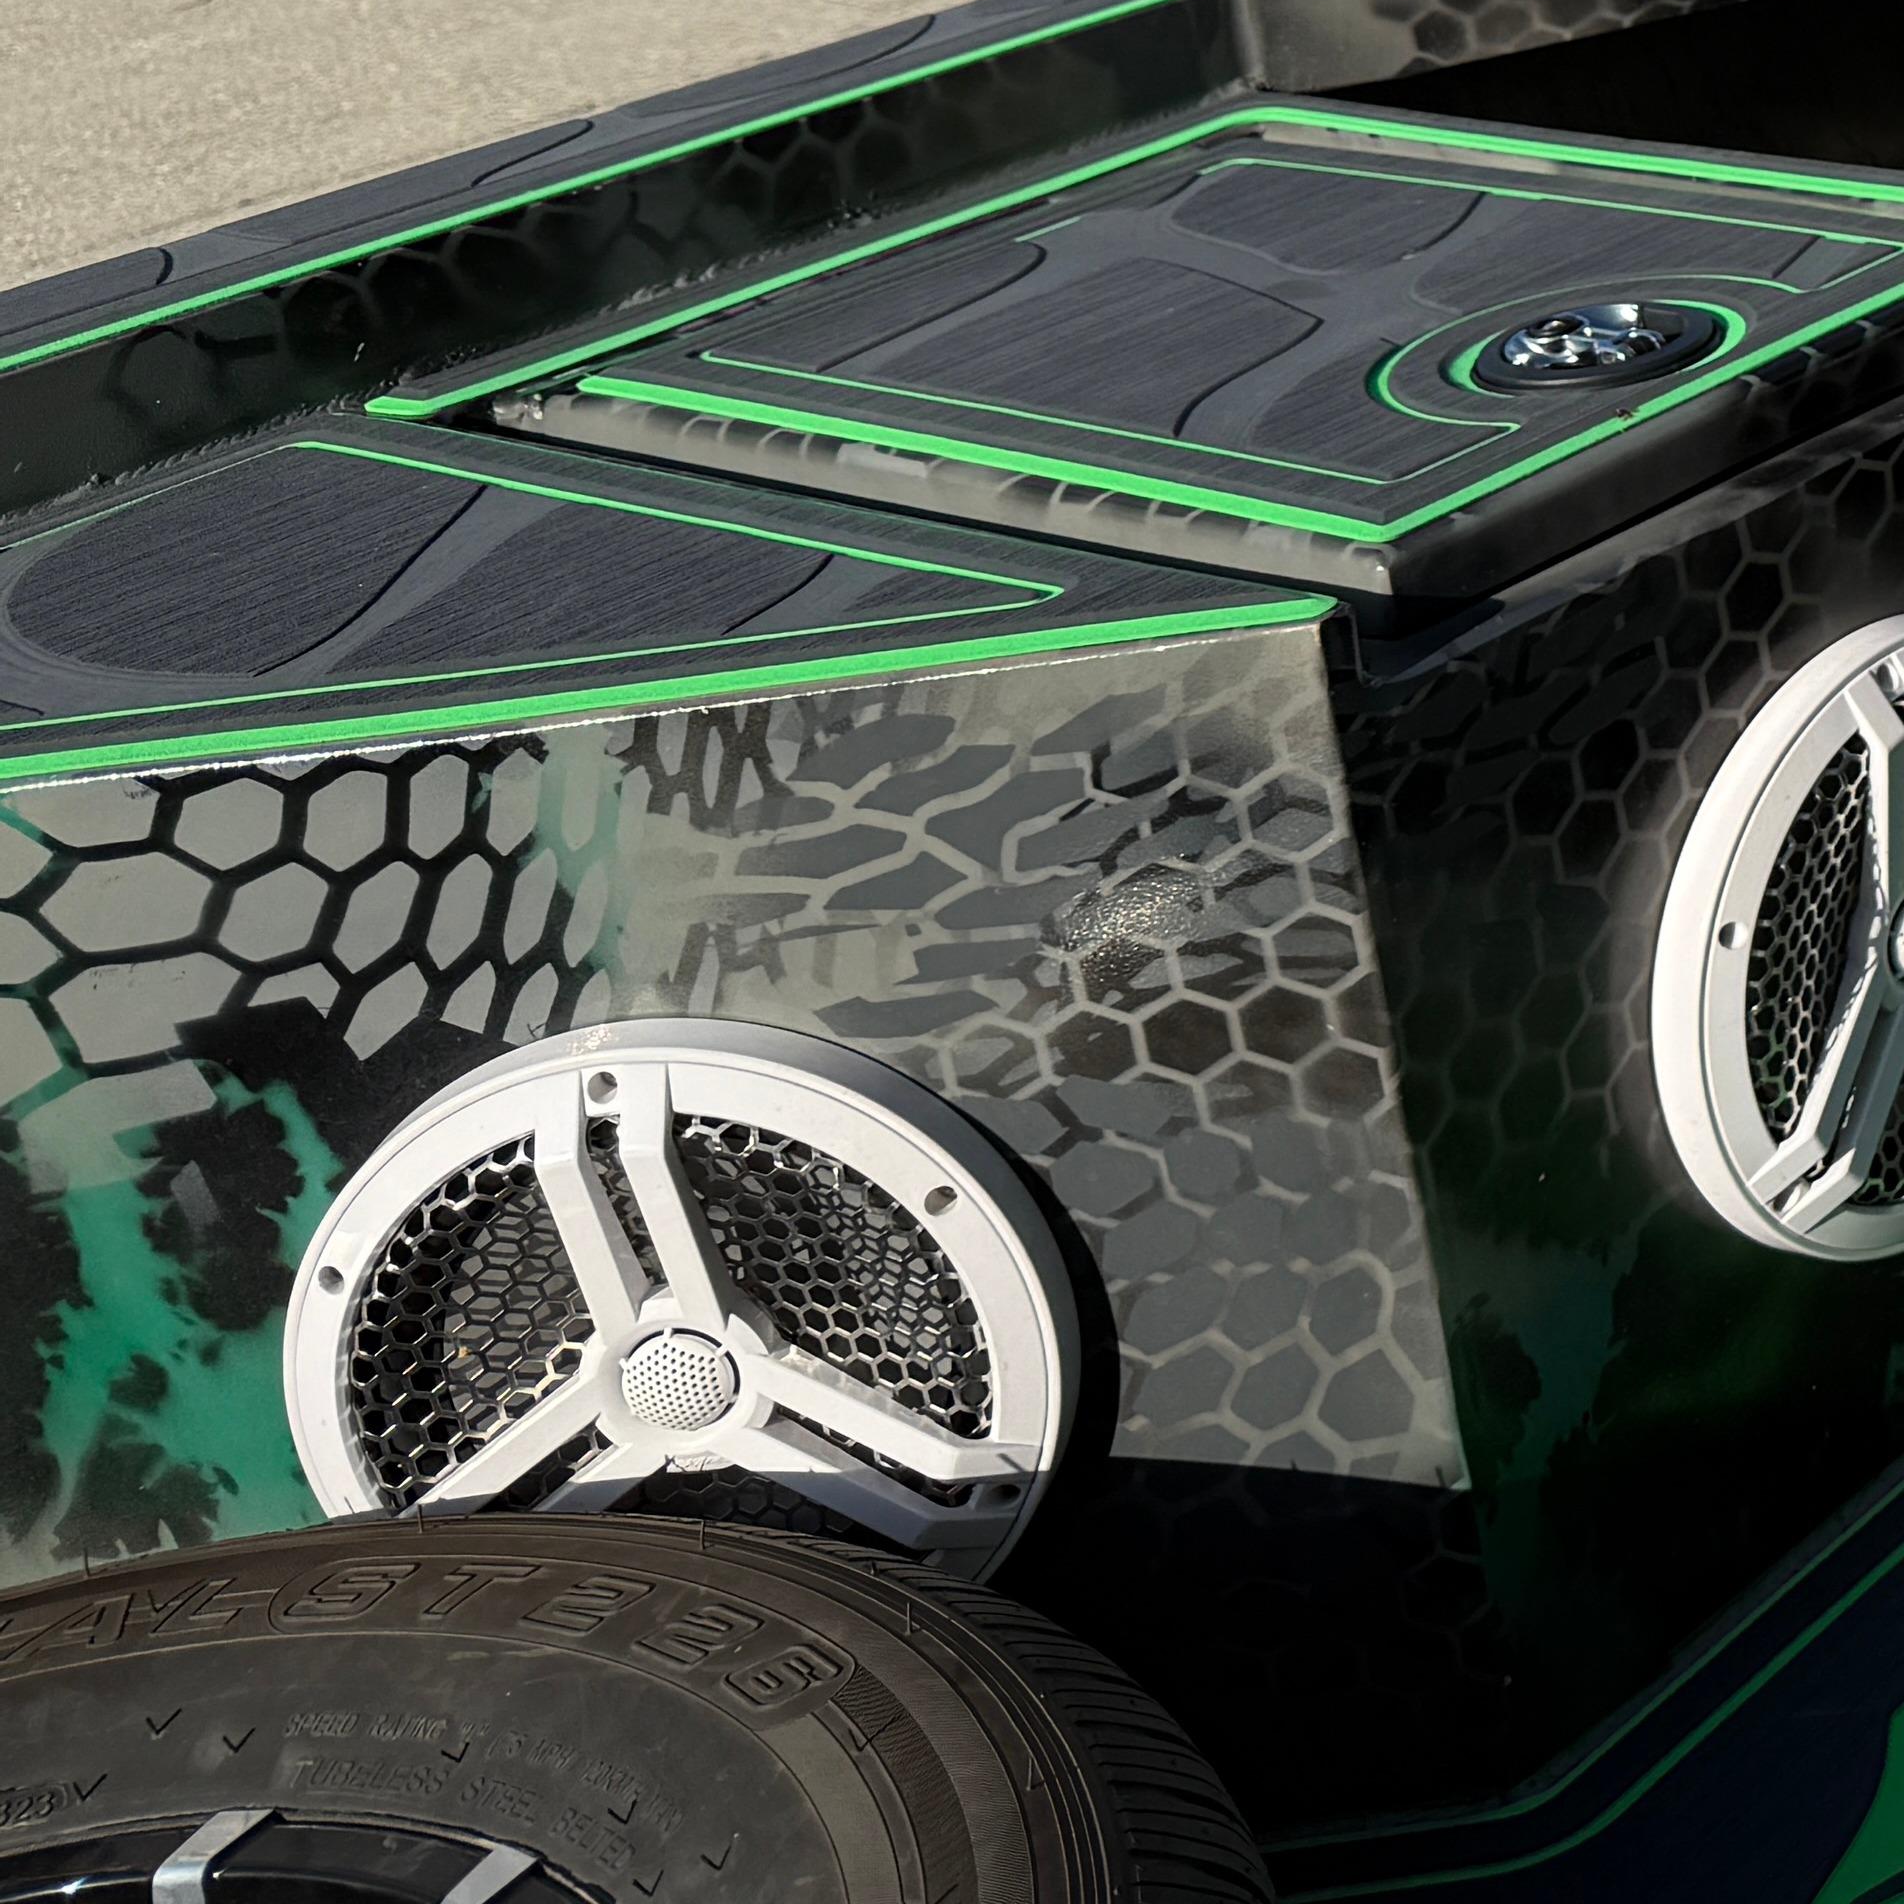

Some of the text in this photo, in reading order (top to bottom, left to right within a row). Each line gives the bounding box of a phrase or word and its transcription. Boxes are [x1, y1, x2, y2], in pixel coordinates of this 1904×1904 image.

[290, 1756, 638, 1872] TUBELESS STEEL BELTED
